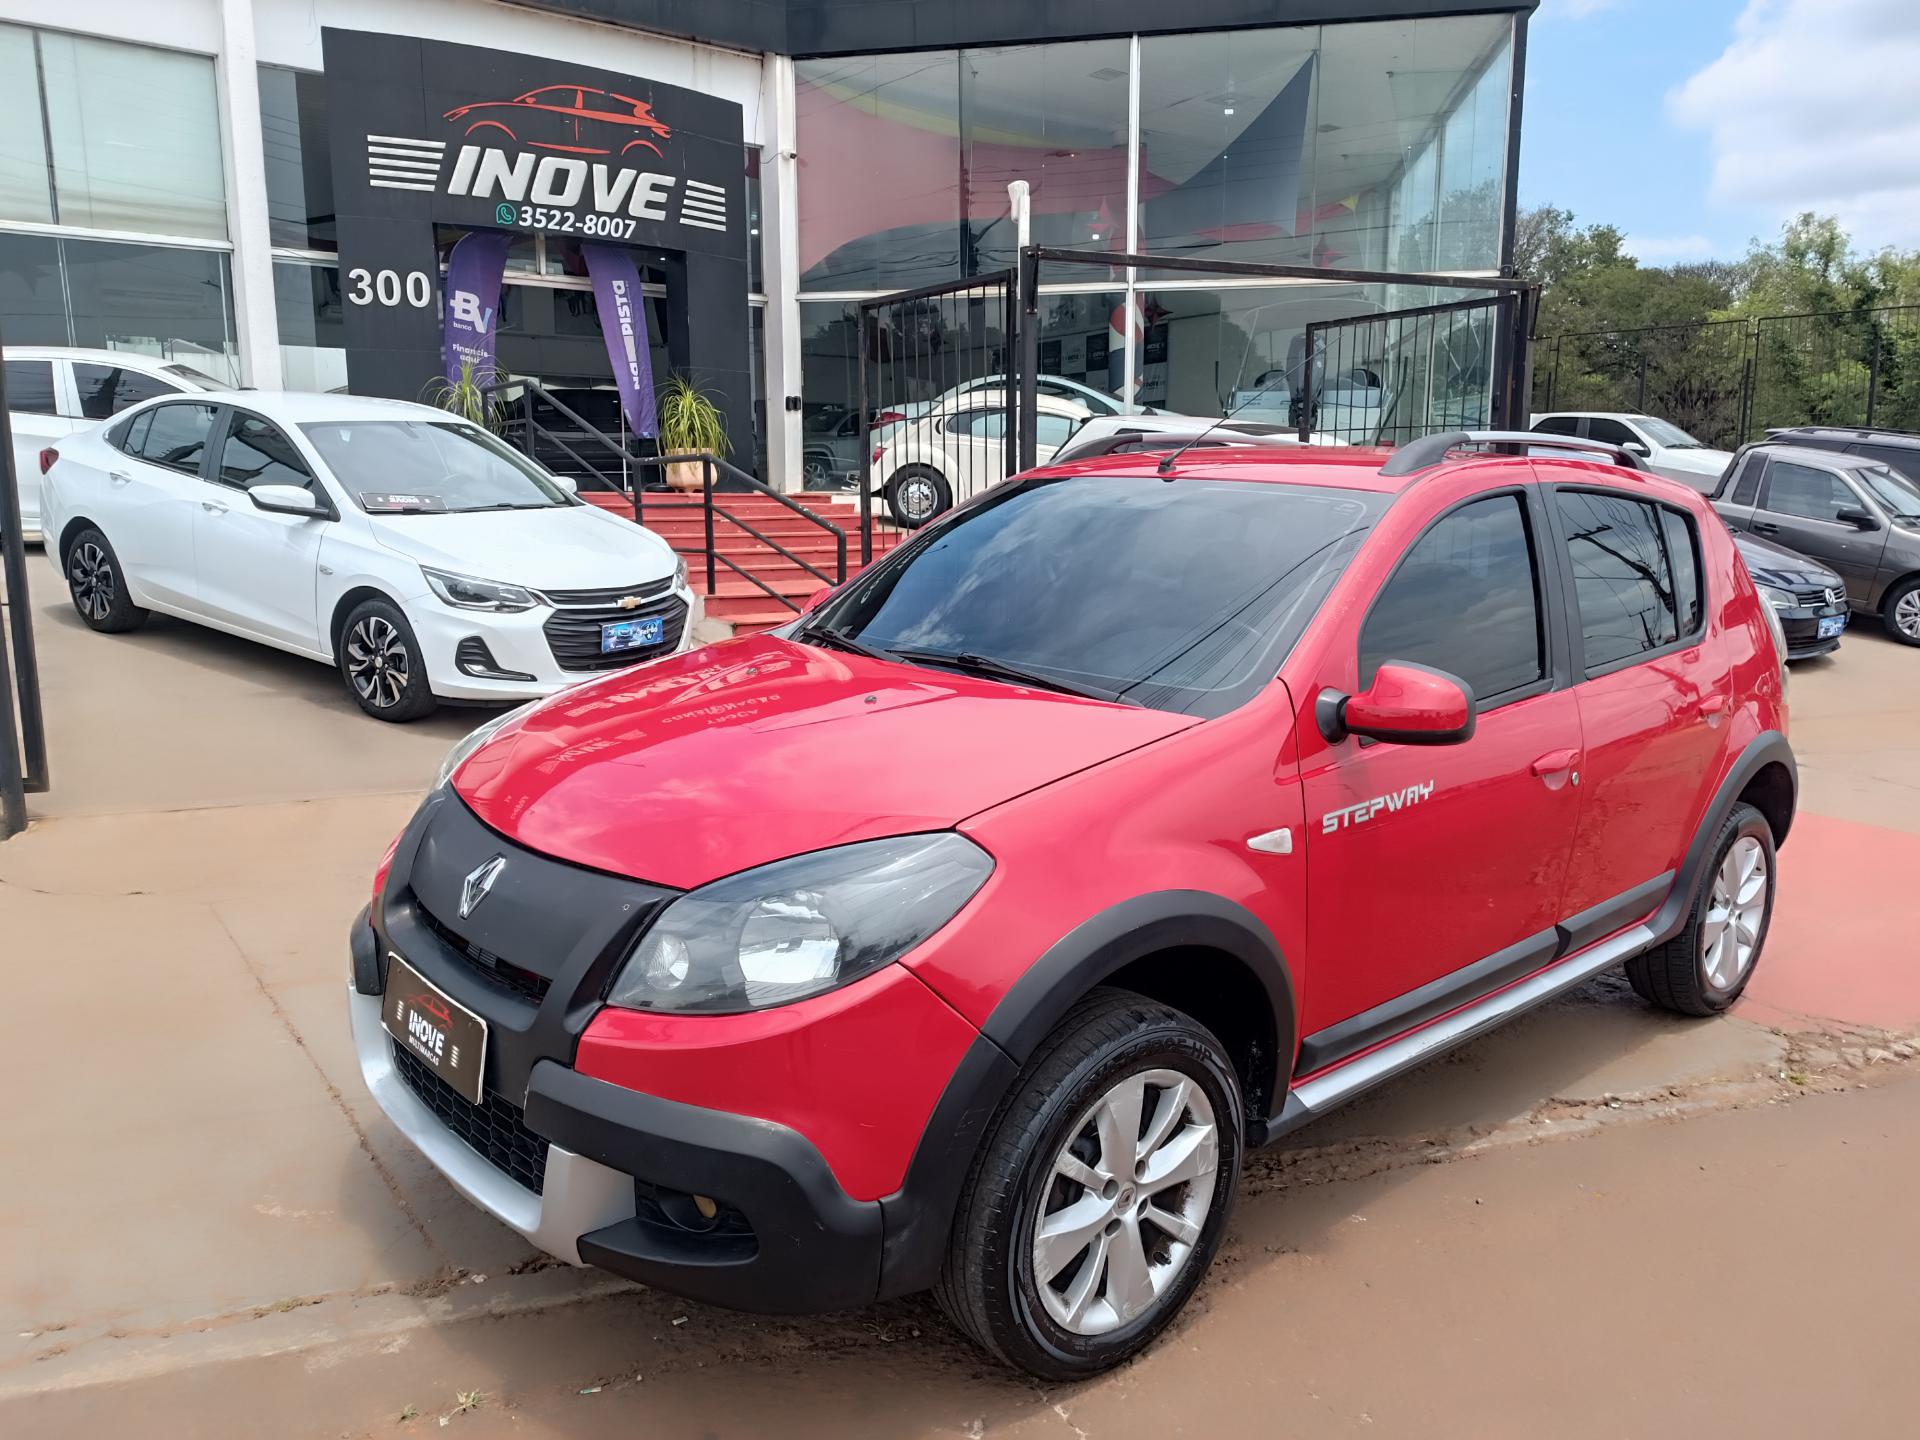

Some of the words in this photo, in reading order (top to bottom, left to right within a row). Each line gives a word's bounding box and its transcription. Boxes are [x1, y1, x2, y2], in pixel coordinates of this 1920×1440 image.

[447, 145, 676, 221] INOVE
[518, 206, 637, 239] 3522-8007
[348, 268, 431, 308] 300
[453, 321, 472, 332] banco
[1322, 779, 1434, 835] STEPWAY
[408, 1009, 445, 1057] INOVE
